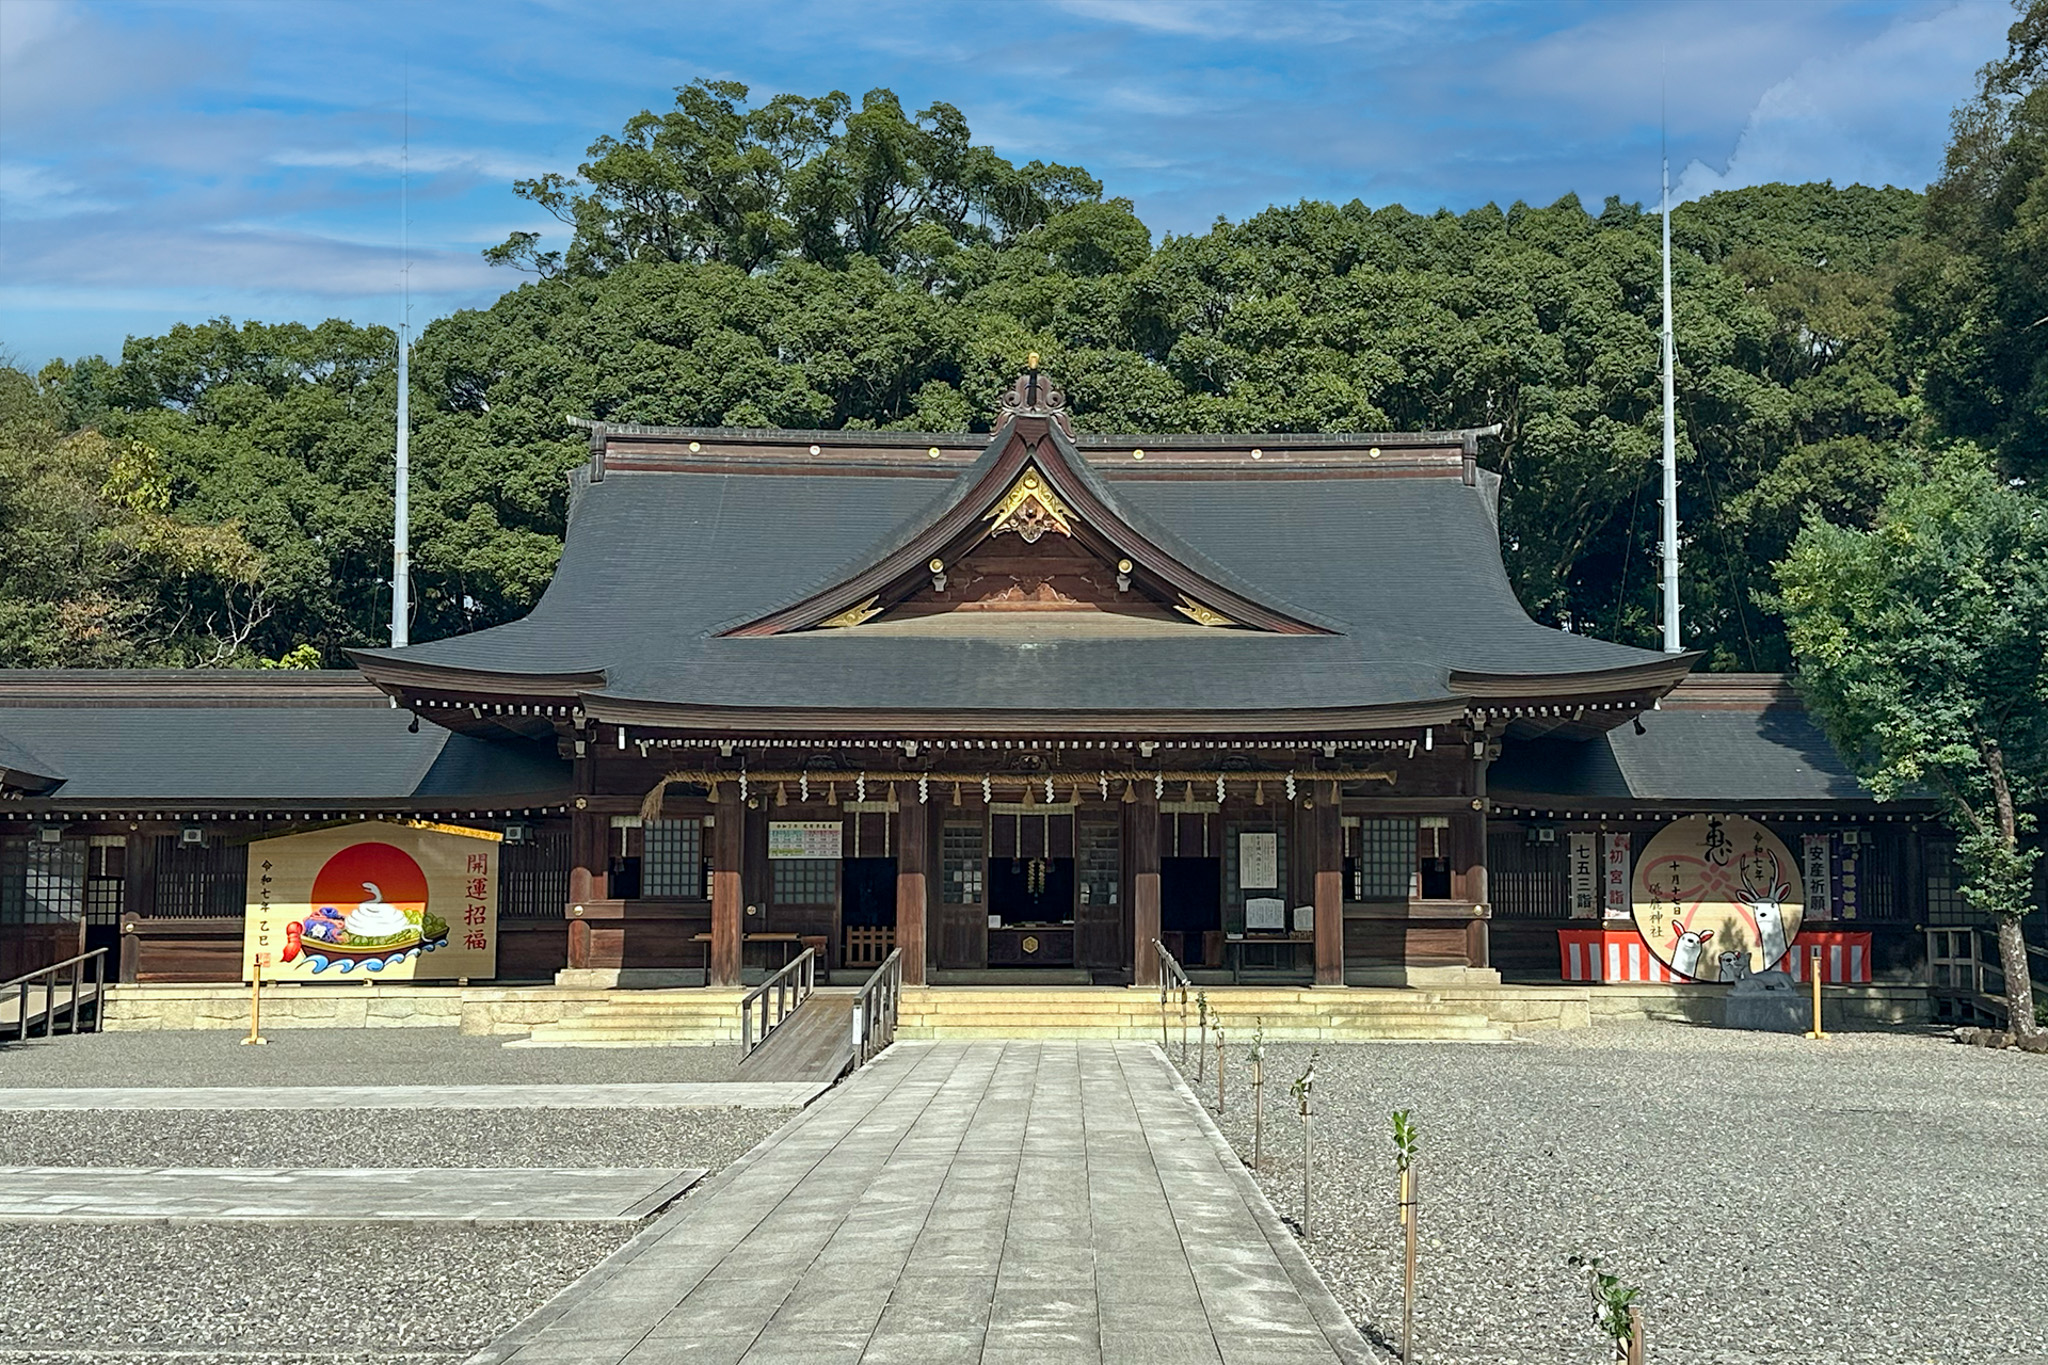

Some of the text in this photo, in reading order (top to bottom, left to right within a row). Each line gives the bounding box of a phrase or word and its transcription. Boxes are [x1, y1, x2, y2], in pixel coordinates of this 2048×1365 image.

[1576, 844, 1592, 908] 七五三詣
[1609, 849, 1624, 905] 初宮詣
[1753, 831, 1764, 881] 令和七年
[1809, 846, 1825, 911] 安産祈願
[260, 859, 273, 913] 令和七年
[463, 852, 488, 950] 開運招福
[1669, 860, 1681, 915] 十月十七日
